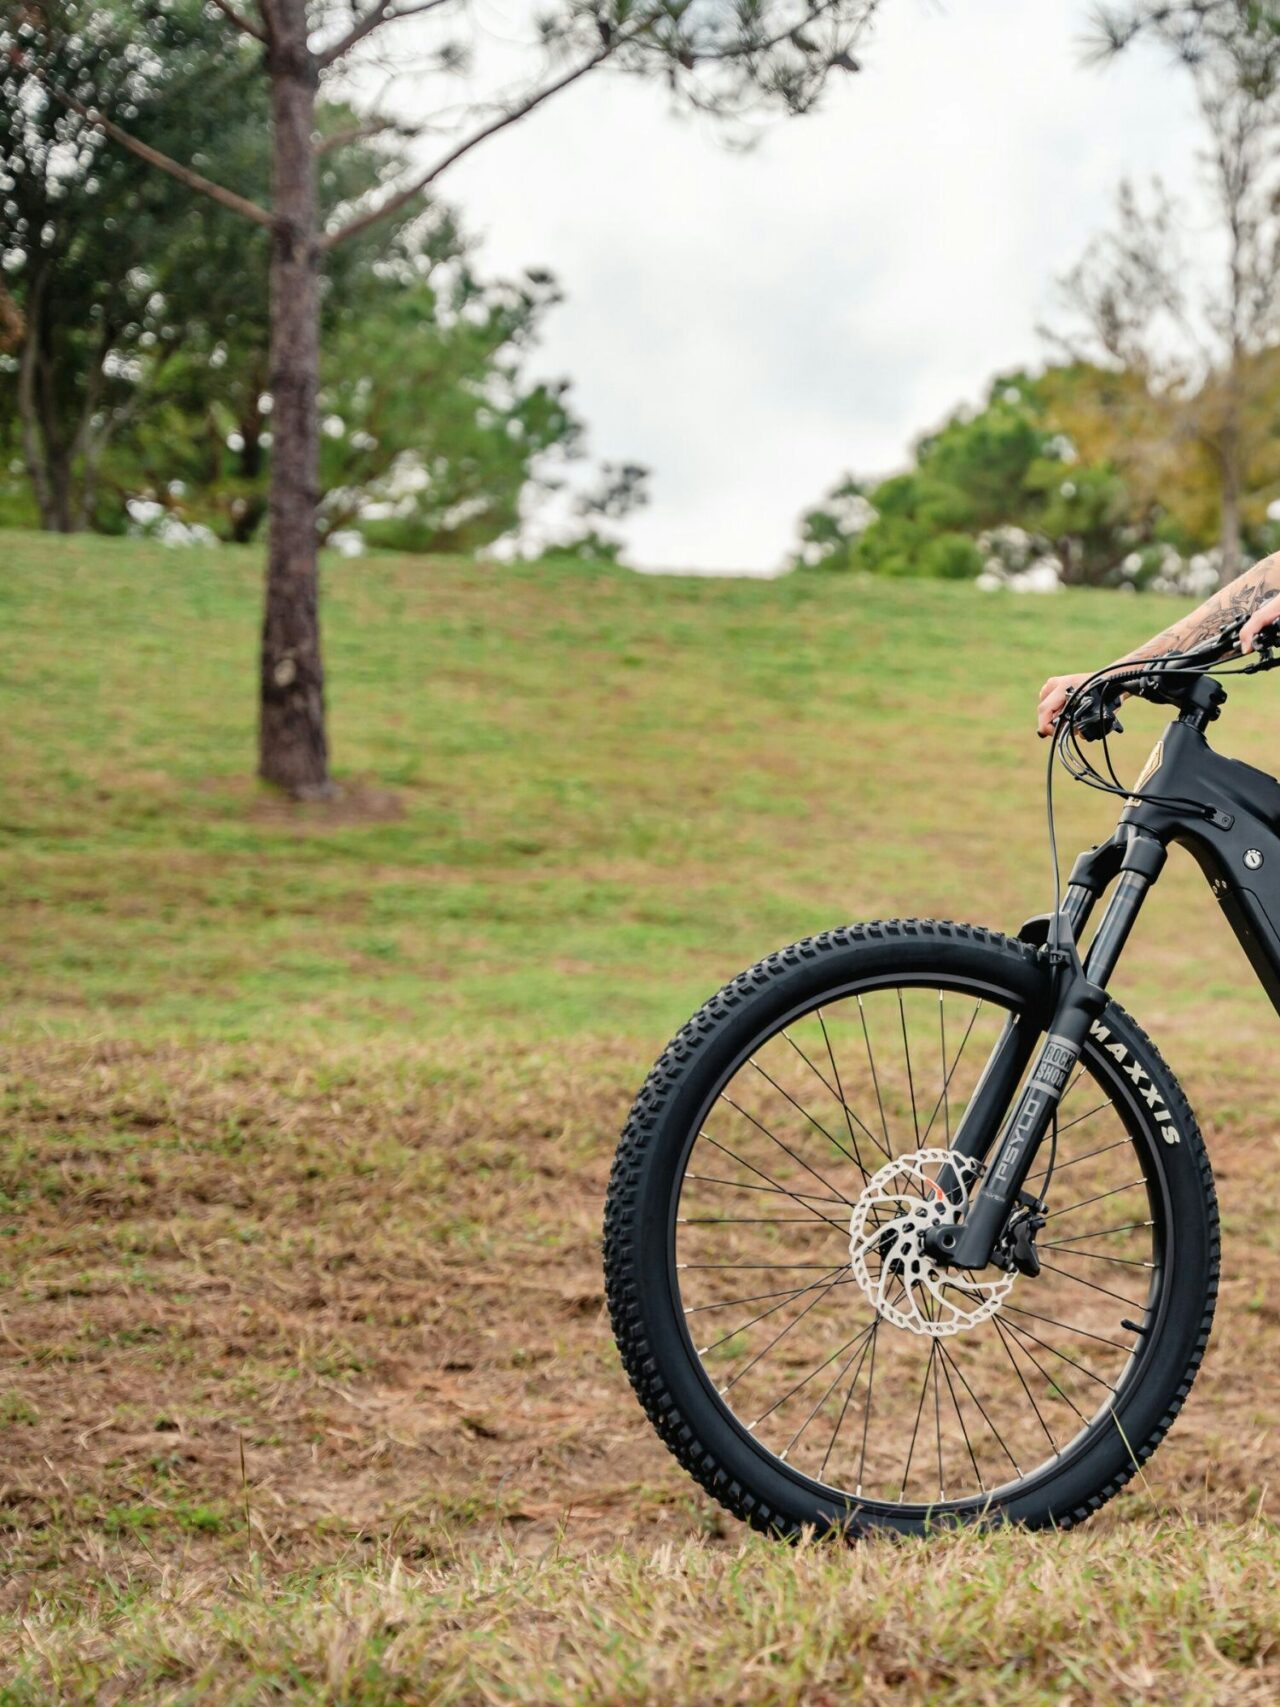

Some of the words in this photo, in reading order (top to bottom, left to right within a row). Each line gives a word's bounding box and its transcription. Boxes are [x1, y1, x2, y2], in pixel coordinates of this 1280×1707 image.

[1035, 1062, 1067, 1088] SHOX
[1044, 1044, 1075, 1070] ROCK
[1089, 1018, 1181, 1145] MAXXIS
[995, 1099, 1041, 1181] PSYLO
